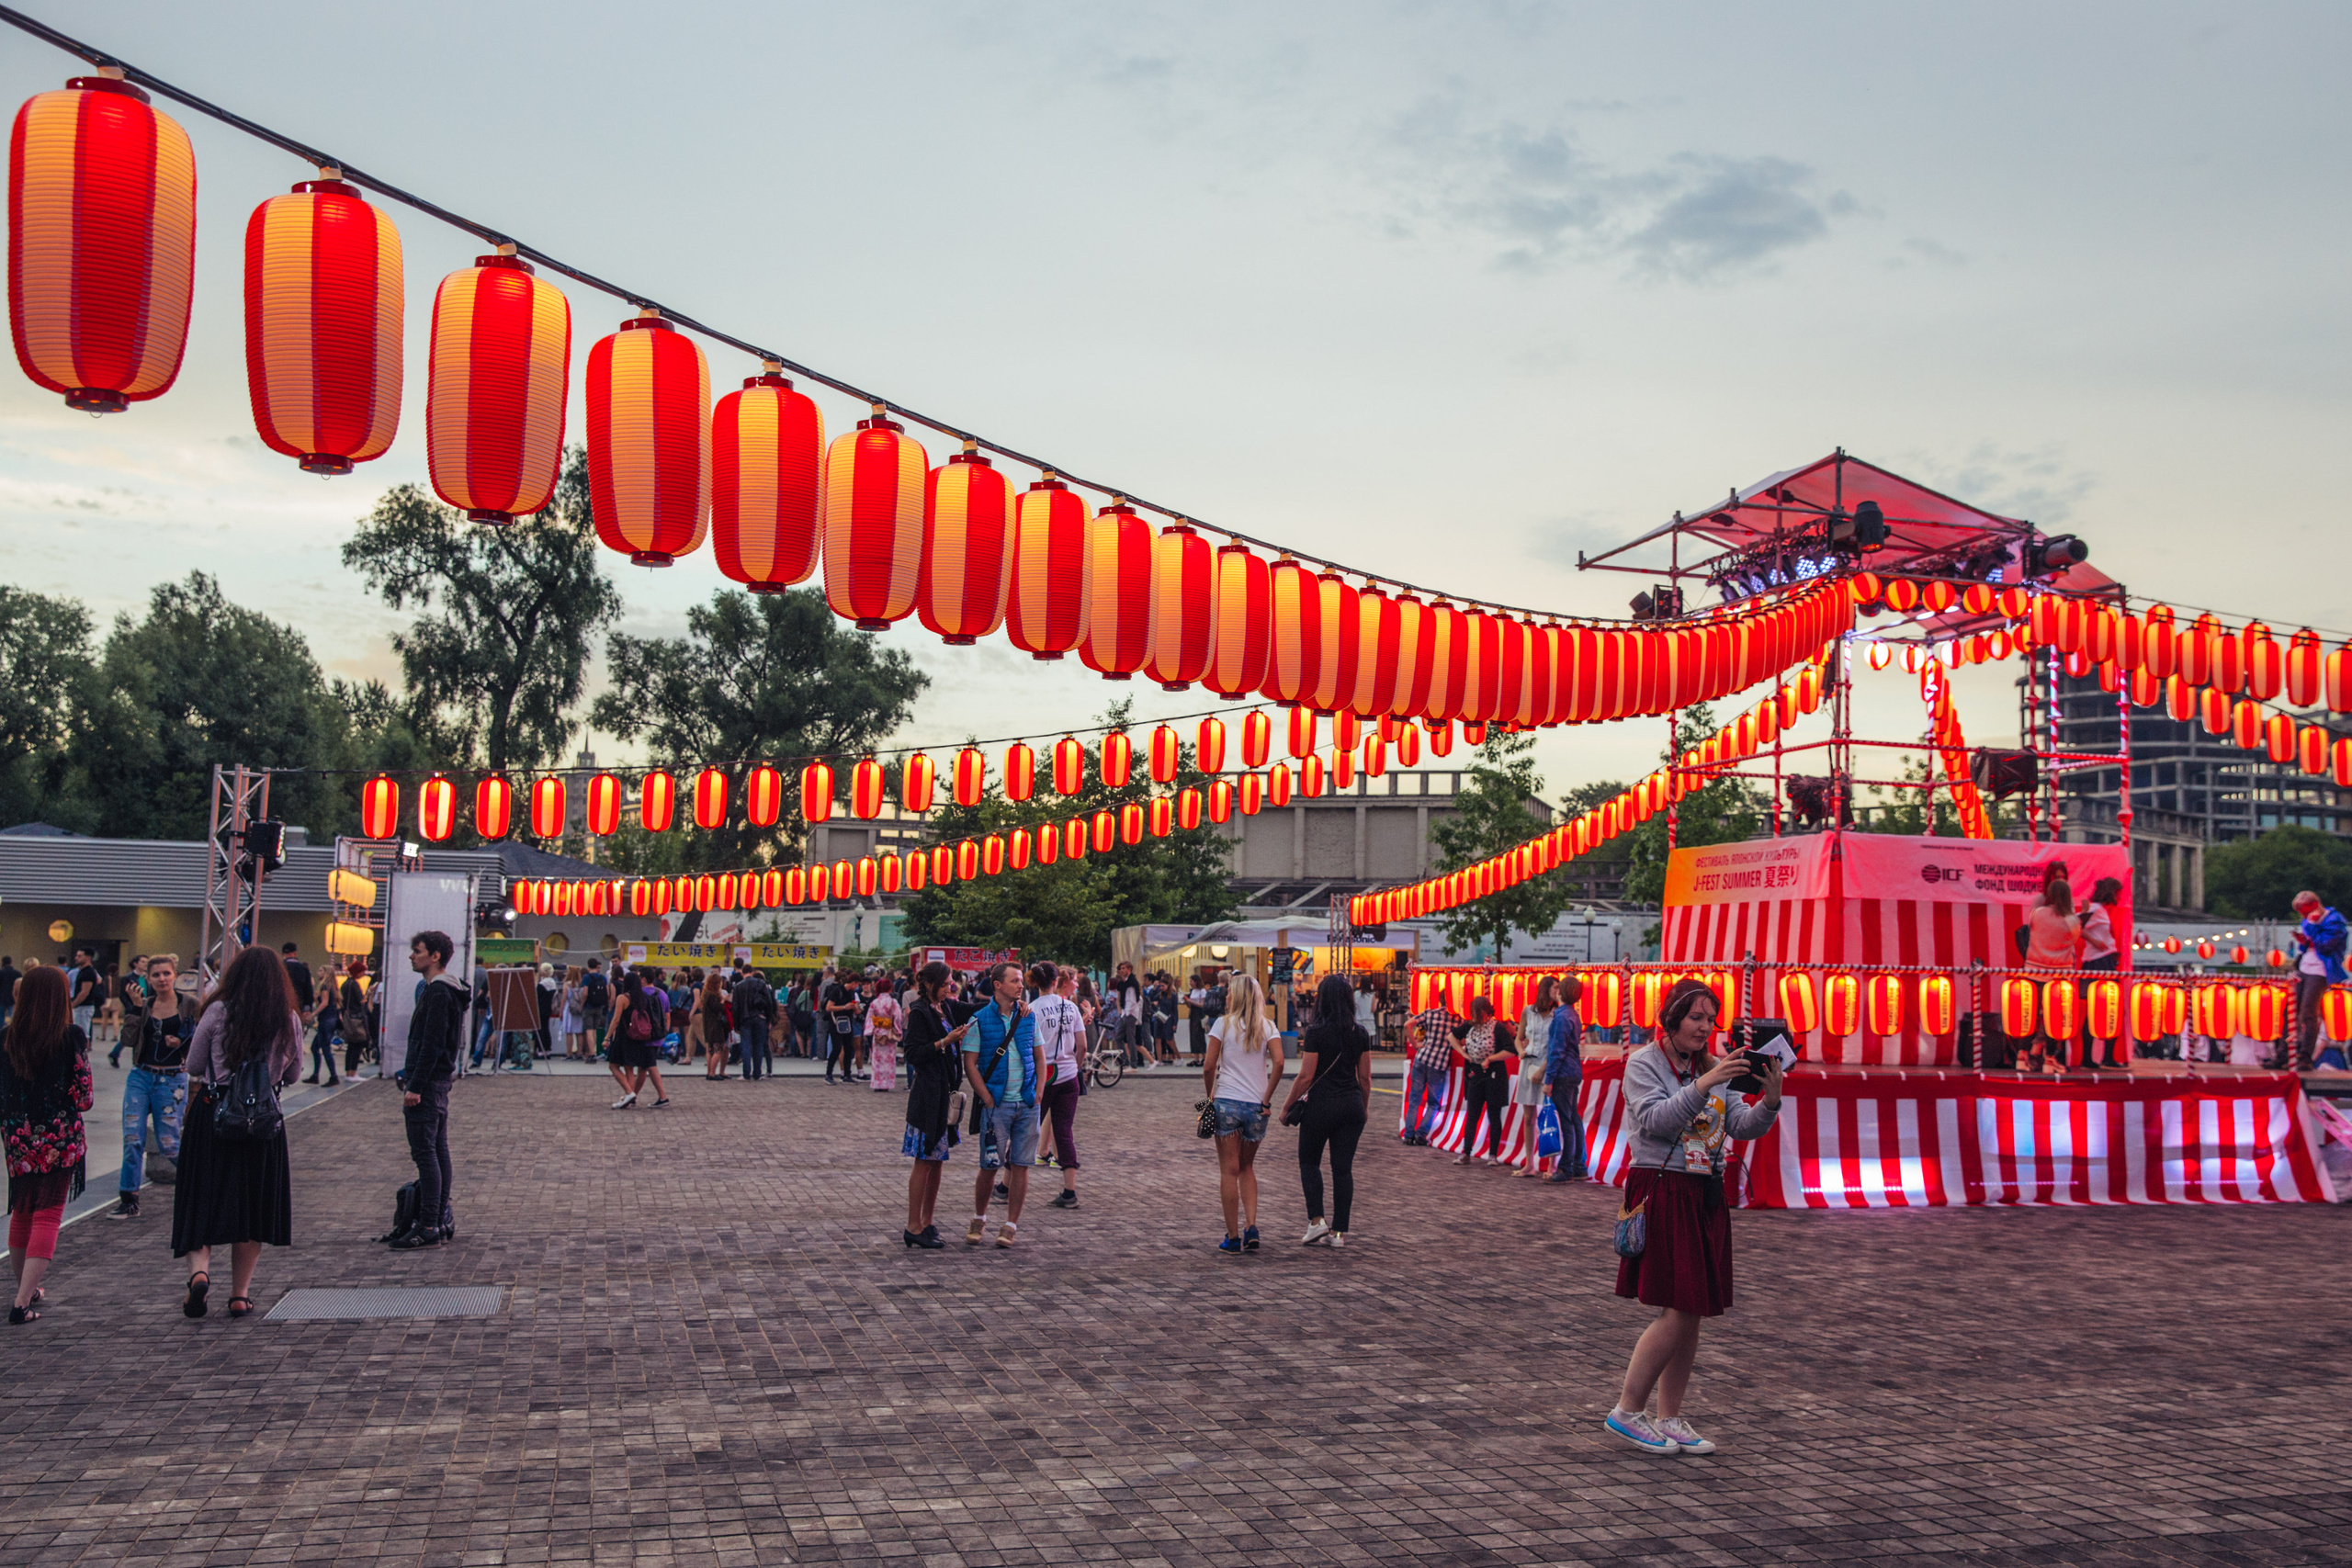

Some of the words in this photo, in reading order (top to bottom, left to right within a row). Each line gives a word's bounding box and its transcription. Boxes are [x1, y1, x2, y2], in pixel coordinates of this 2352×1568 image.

[1693, 874, 1721, 891] J-FEST
[1722, 870, 1761, 889] SUMMER
[1764, 864, 1800, 888] 夏祭り
[1941, 868, 1964, 882] ICF
[1974, 864, 2045, 877] МЕЖДУНАРОДН
[1975, 879, 2005, 893] ФОНД
[657, 944, 717, 958] たい焼き
[762, 945, 820, 959] たい焼き
[1041, 1006, 1055, 1017] I'M
[1046, 1018, 1057, 1029] TO
